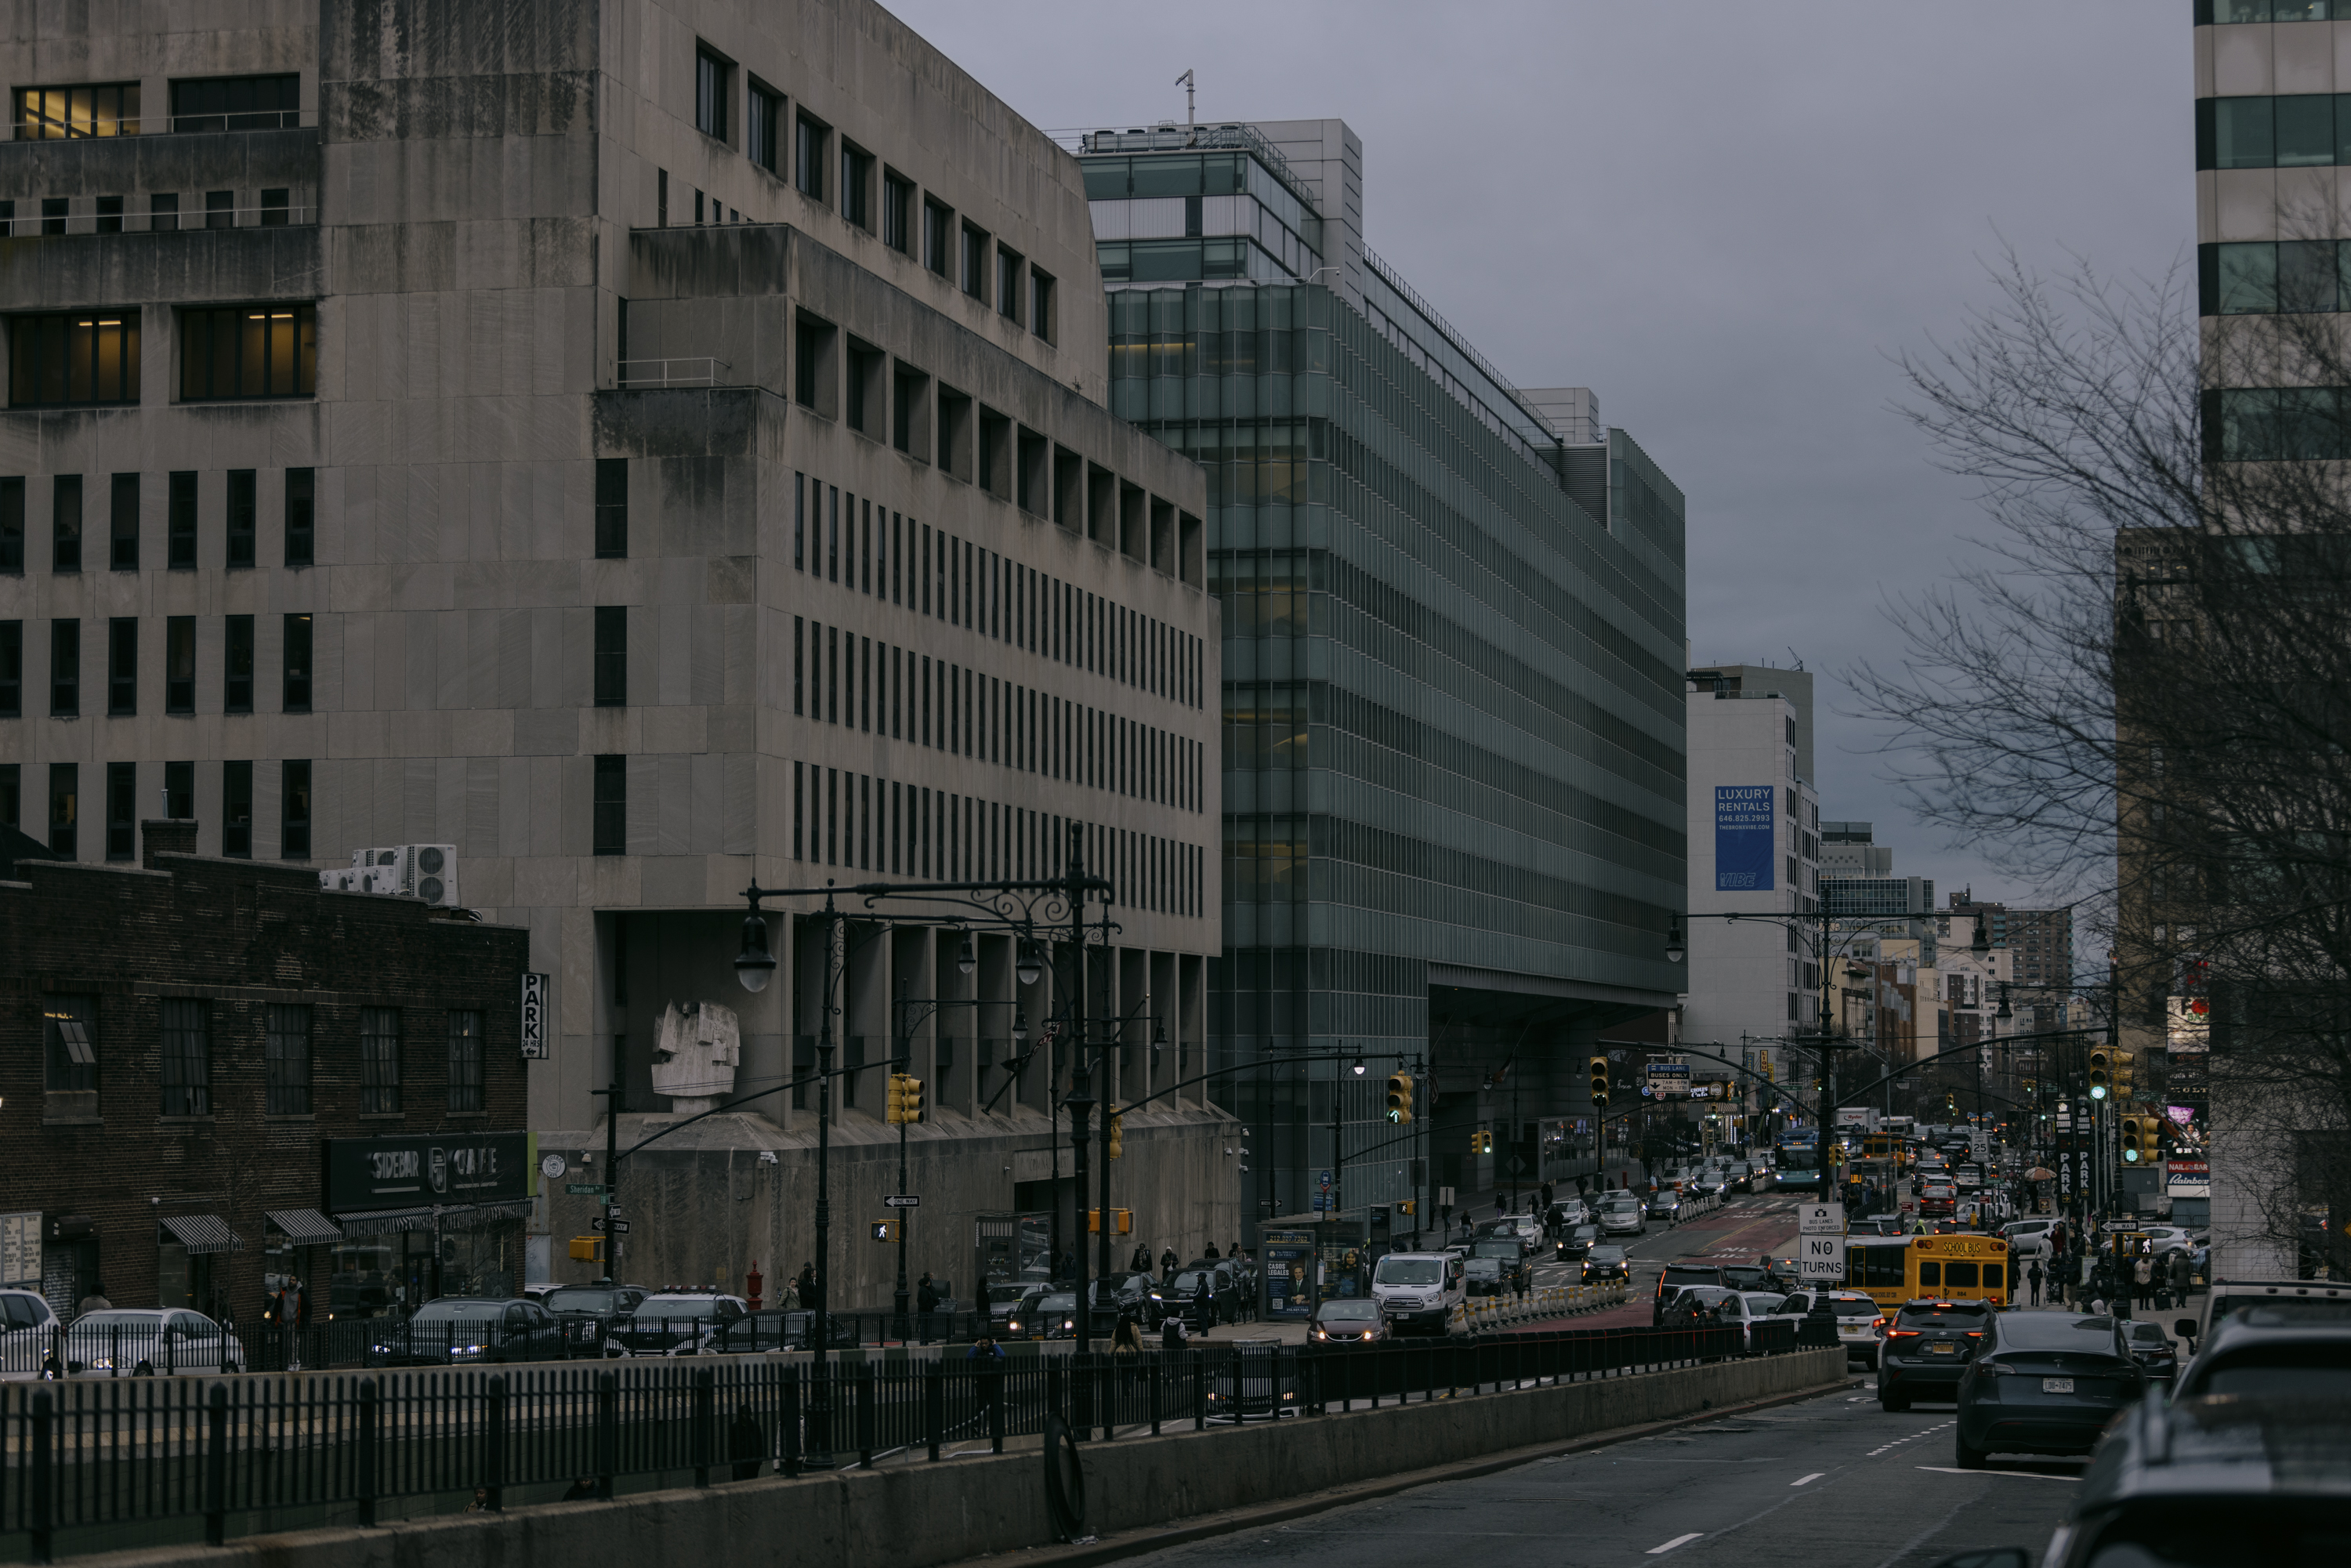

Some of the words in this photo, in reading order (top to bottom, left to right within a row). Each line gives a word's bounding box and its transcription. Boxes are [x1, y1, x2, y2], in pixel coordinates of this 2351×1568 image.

[1718, 788, 1770, 799] LUXURY
[1719, 802, 1770, 812] RENTALS
[1722, 872, 1756, 887] VIBE
[523, 975, 540, 1039] PARK
[1973, 1143, 1987, 1152] 25
[371, 1150, 419, 1179] SIDEBAR
[1057, 1156, 1069, 1169] OURT
[2059, 1153, 2071, 1194] PARK
[2079, 1151, 2089, 1188] PARK
[2168, 1173, 2209, 1185] Rainbow
[570, 1185, 594, 1193] Sheridan
[1811, 1240, 1833, 1255] NO
[1943, 1242, 1967, 1253] SCHOOL
[1968, 1243, 1980, 1253] BUS
[1802, 1261, 1842, 1273] TURNS
